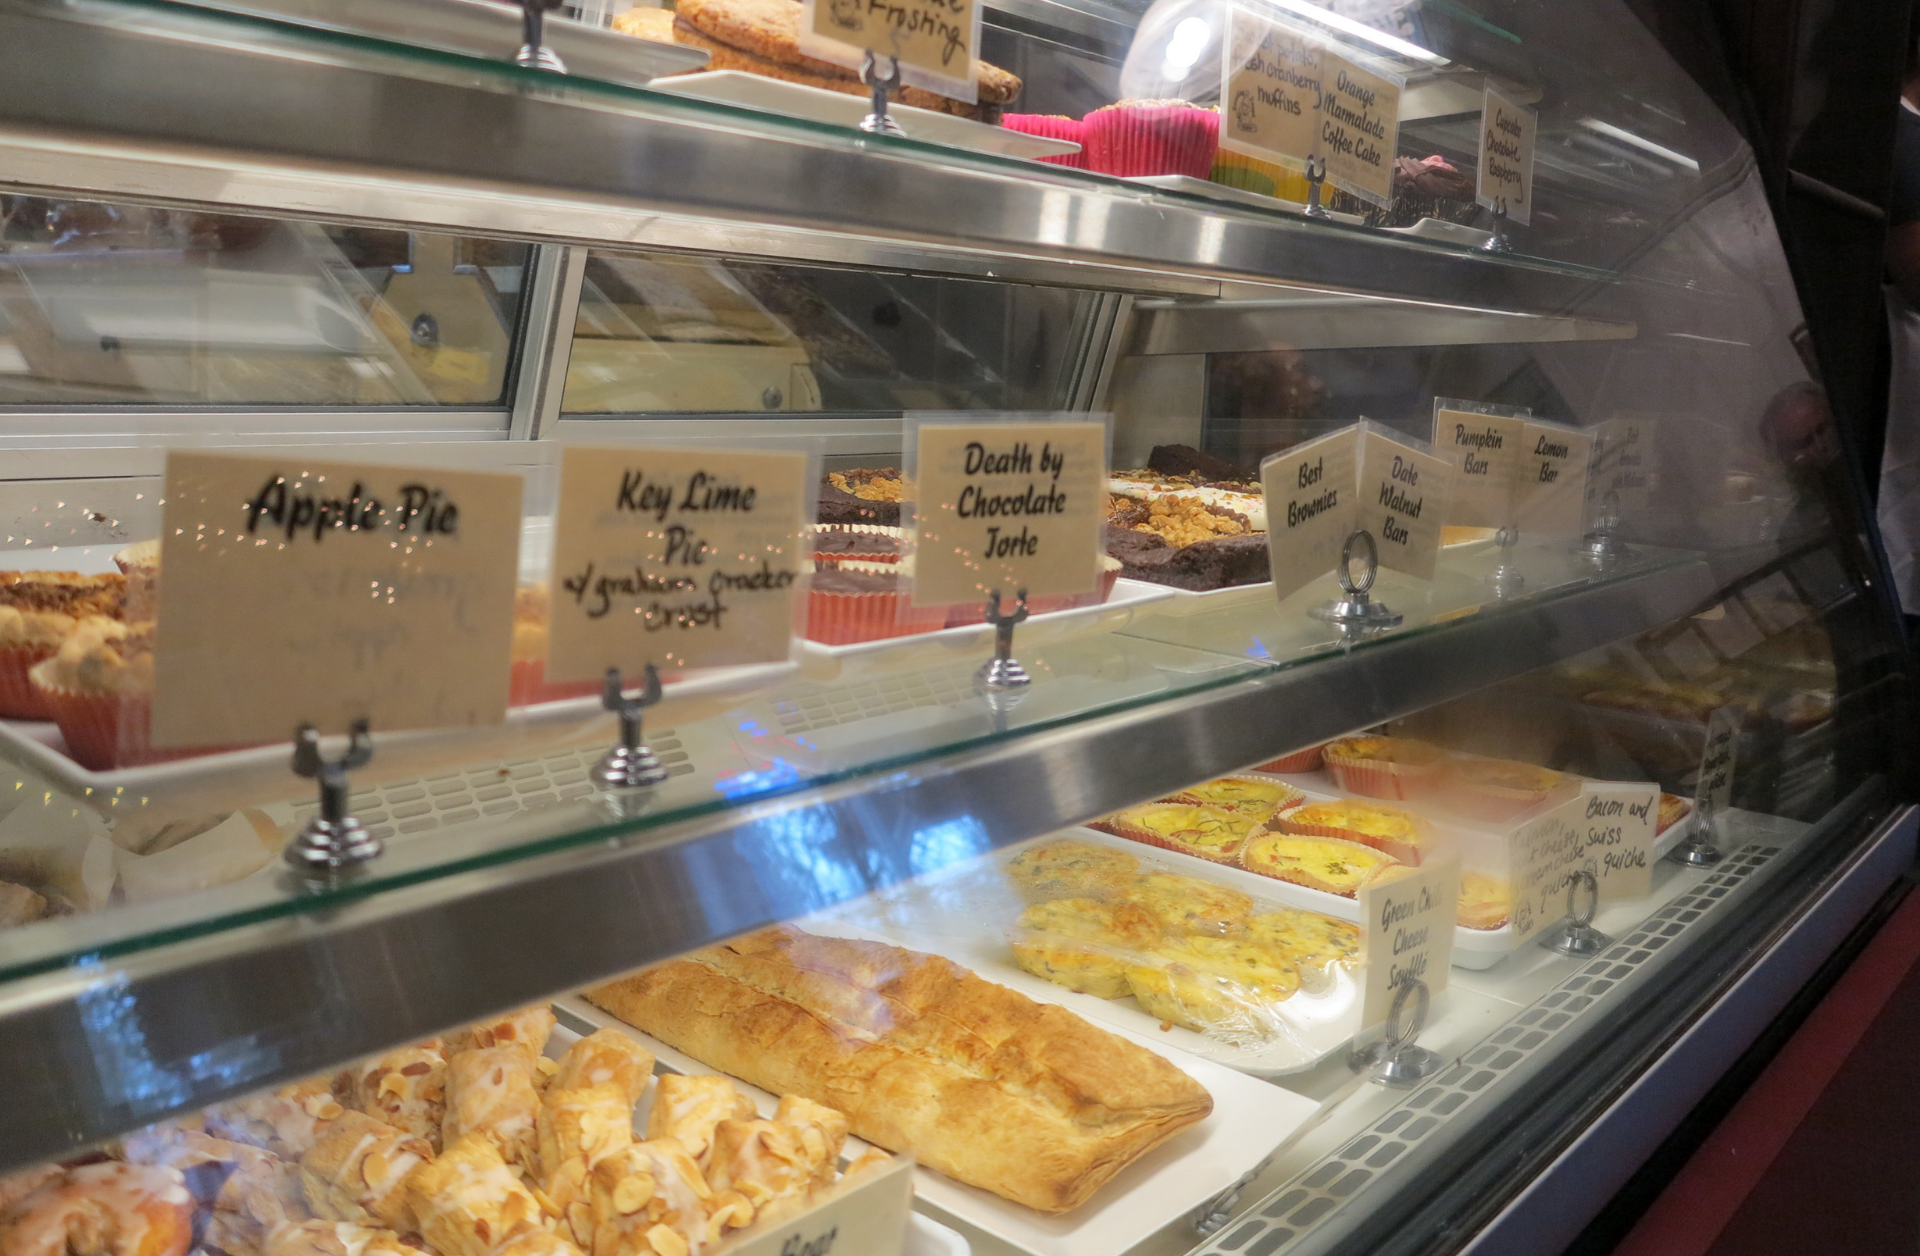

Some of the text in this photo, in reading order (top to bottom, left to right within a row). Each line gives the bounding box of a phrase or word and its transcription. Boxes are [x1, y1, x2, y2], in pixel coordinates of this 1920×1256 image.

[1257, 85, 1302, 117] muffins
[1265, 61, 1323, 110] cranberry
[1337, 69, 1375, 110] Orange
[1322, 91, 1386, 140] Marmalade
[1496, 107, 1522, 139] Cupcake
[1322, 120, 1381, 167] Coffee Cake
[1486, 129, 1521, 163] Chocolate
[1489, 157, 1524, 204] Raspberry
[1455, 423, 1503, 452] Pumpkin
[1533, 435, 1569, 459] Lemon
[964, 441, 1064, 480] Death by
[1298, 456, 1323, 490] Best
[1391, 455, 1419, 487] Date
[1463, 452, 1488, 476] Bars
[1538, 461, 1559, 484] Bar
[245, 474, 460, 543] Apple Pie
[616, 468, 757, 522] Key Lime
[957, 482, 1067, 519] Chocolate
[1287, 487, 1338, 529] Brownies
[1378, 481, 1423, 519] Walnut
[664, 525, 708, 566] Pie
[1382, 515, 1409, 546] Bars
[1586, 796, 1654, 826] Bacon and
[1604, 847, 1646, 877] quiche
[1381, 897, 1415, 934] Green
[1392, 925, 1430, 956] Cheese
